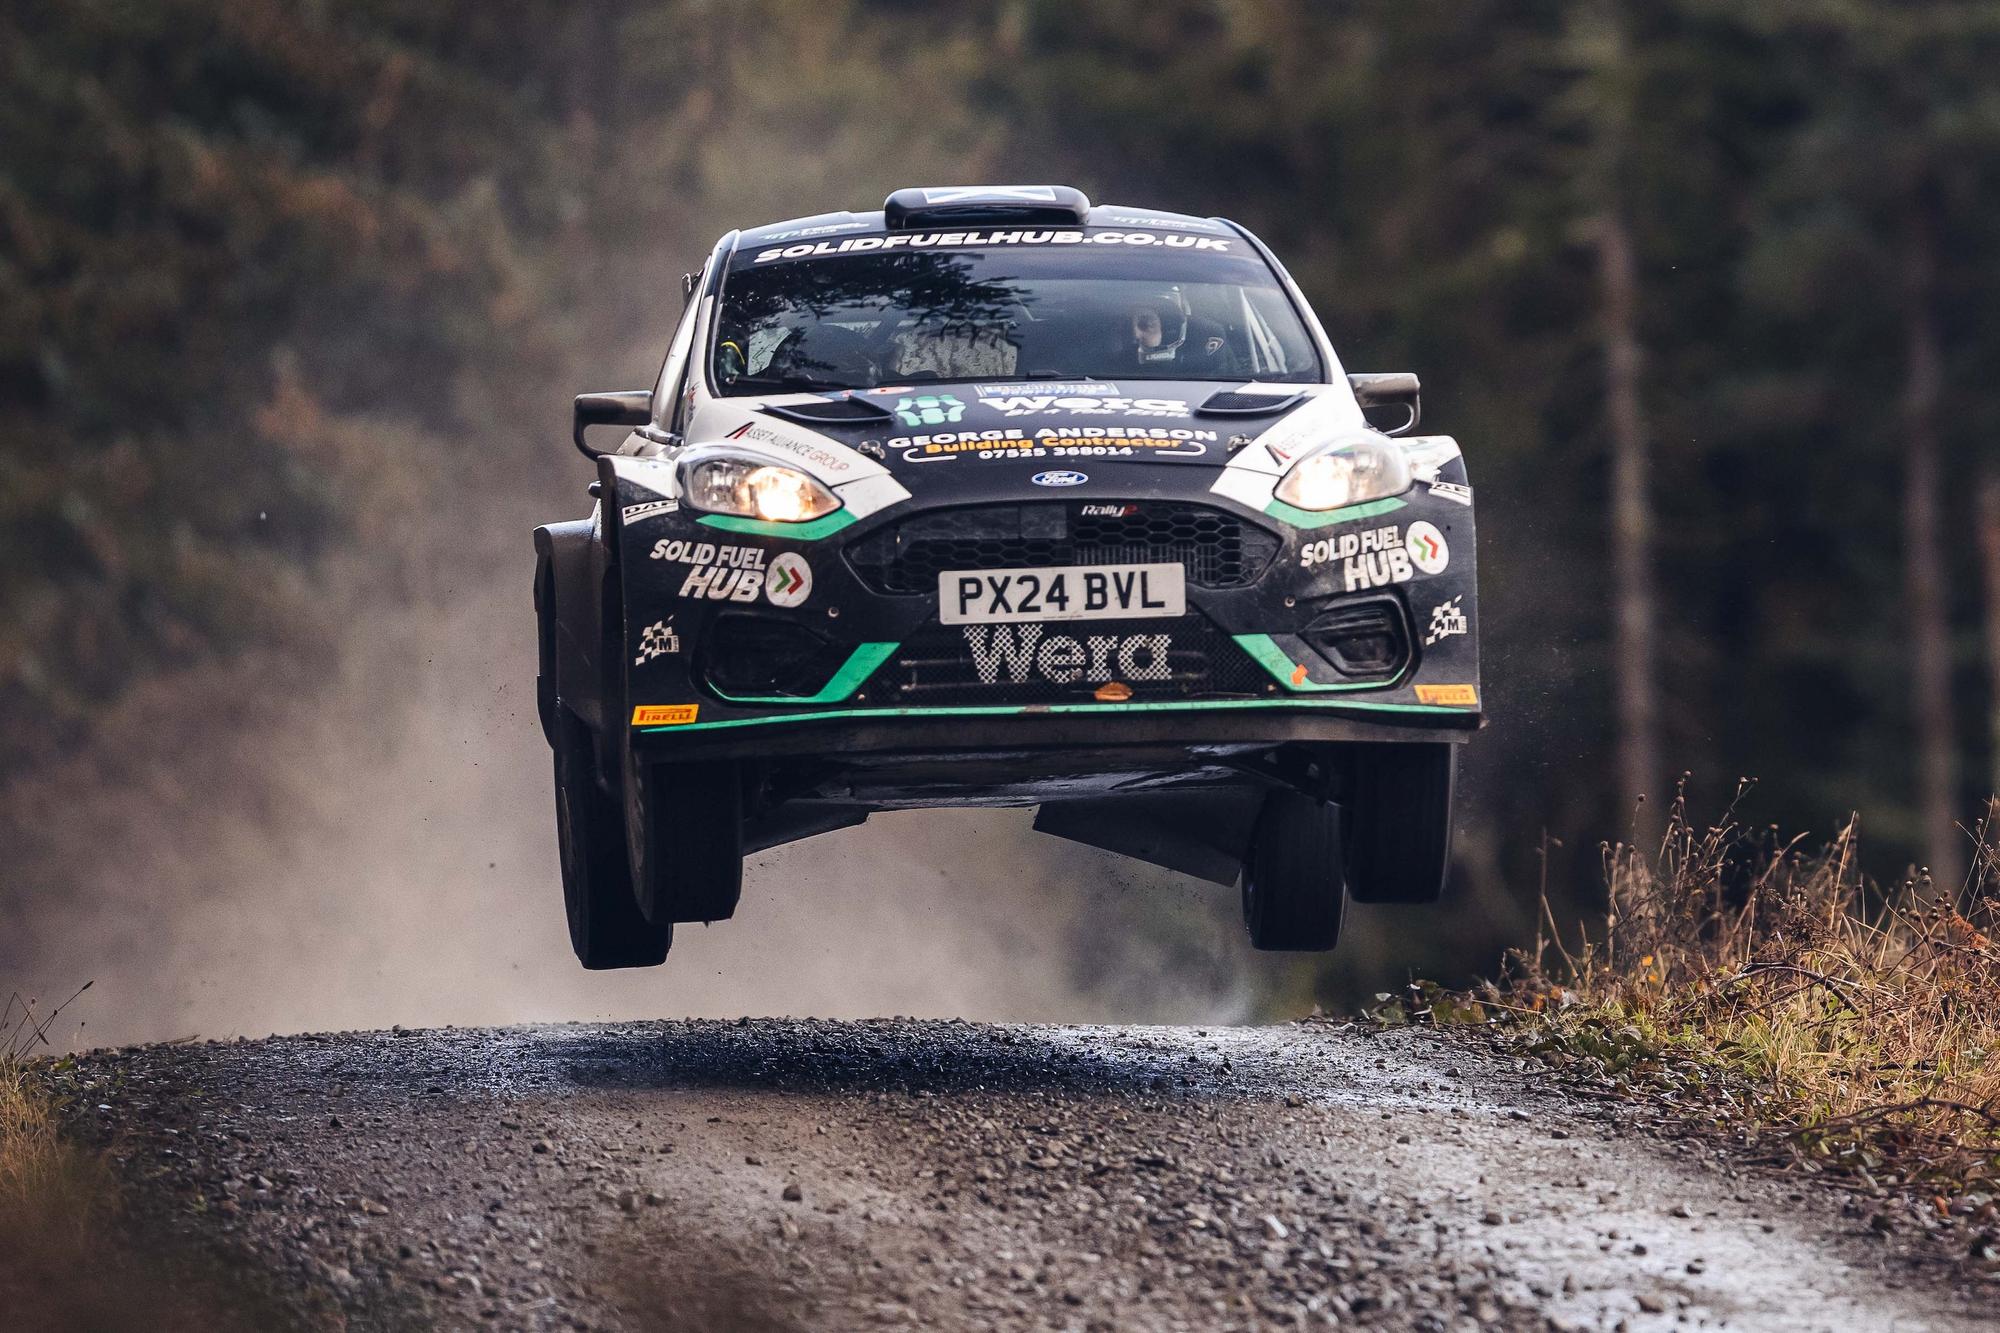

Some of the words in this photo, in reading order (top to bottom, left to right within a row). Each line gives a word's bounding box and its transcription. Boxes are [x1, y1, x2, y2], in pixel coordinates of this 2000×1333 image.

[754, 230, 1232, 263] SOLIDFUELHUB.CO.UK
[888, 429, 1024, 448] GEORGE
[1035, 427, 1218, 441] ANDERSON
[925, 438, 1035, 453] Building
[1042, 436, 1183, 448] Contractor
[809, 450, 849, 470] GROUP
[1041, 472, 1079, 486] Ford
[1081, 505, 1138, 518] Rally2
[650, 538, 716, 566] SOLID
[716, 545, 767, 571] FUEL
[1301, 533, 1359, 568] SOLID
[1360, 525, 1405, 554] FUEL
[1344, 548, 1414, 592] HUB
[678, 564, 765, 603] HUB
[958, 573, 1070, 616] PX24
[1083, 570, 1166, 611] BVL
[1447, 618, 1460, 631] M
[659, 637, 672, 651] M
[963, 624, 1173, 684] Wera
[639, 707, 692, 721] PIRELLI
